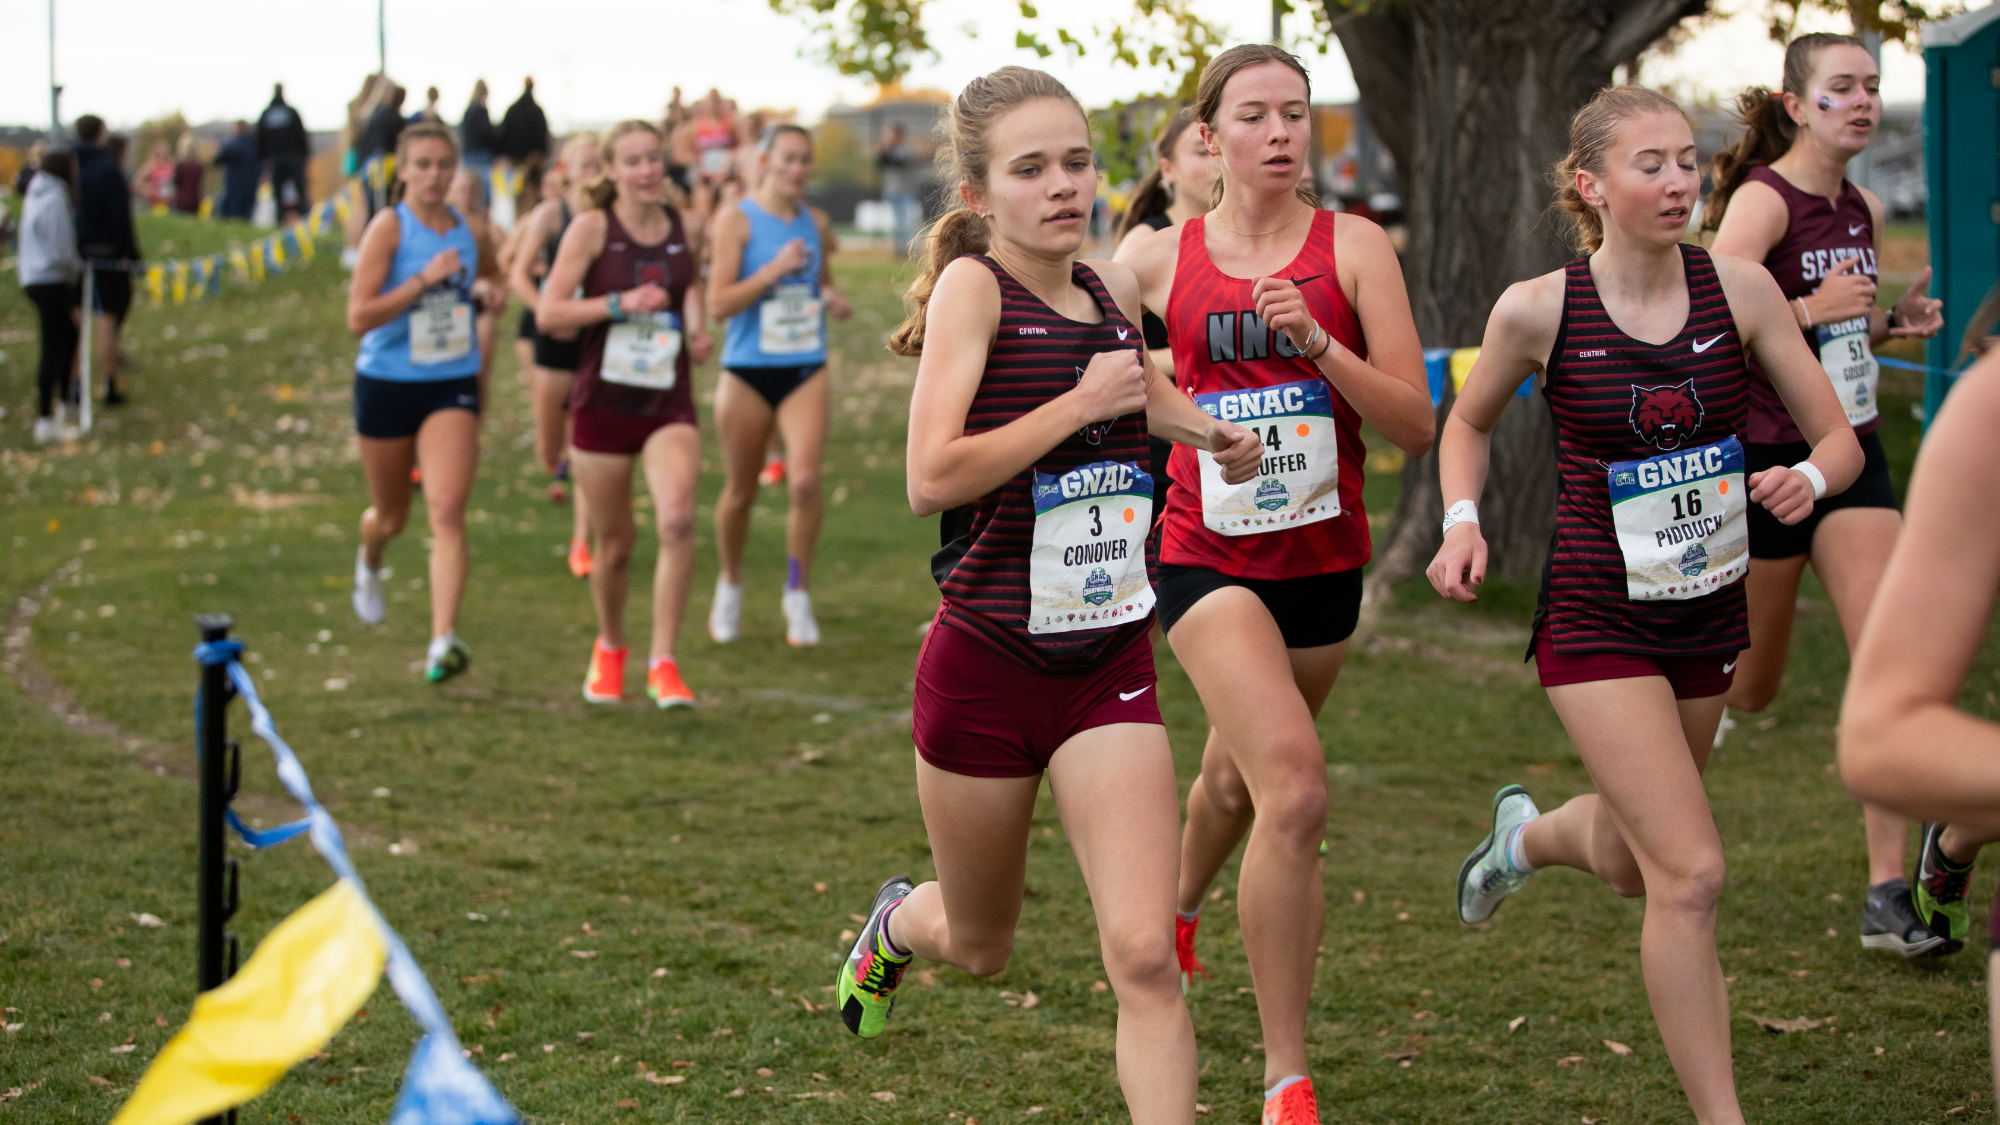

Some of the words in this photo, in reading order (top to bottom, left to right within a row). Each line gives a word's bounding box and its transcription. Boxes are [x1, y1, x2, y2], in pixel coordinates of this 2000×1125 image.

[1579, 350, 1607, 358] CENTRAL
[1848, 339, 1864, 361] 51
[1220, 386, 1304, 420] GNAC
[1257, 453, 1307, 476] UFFER
[1637, 446, 1722, 489] GNAC
[1059, 463, 1134, 499] GNAC
[1088, 505, 1103, 537] 3
[1671, 489, 1702, 521] 16
[1063, 539, 1127, 567] CONOVER
